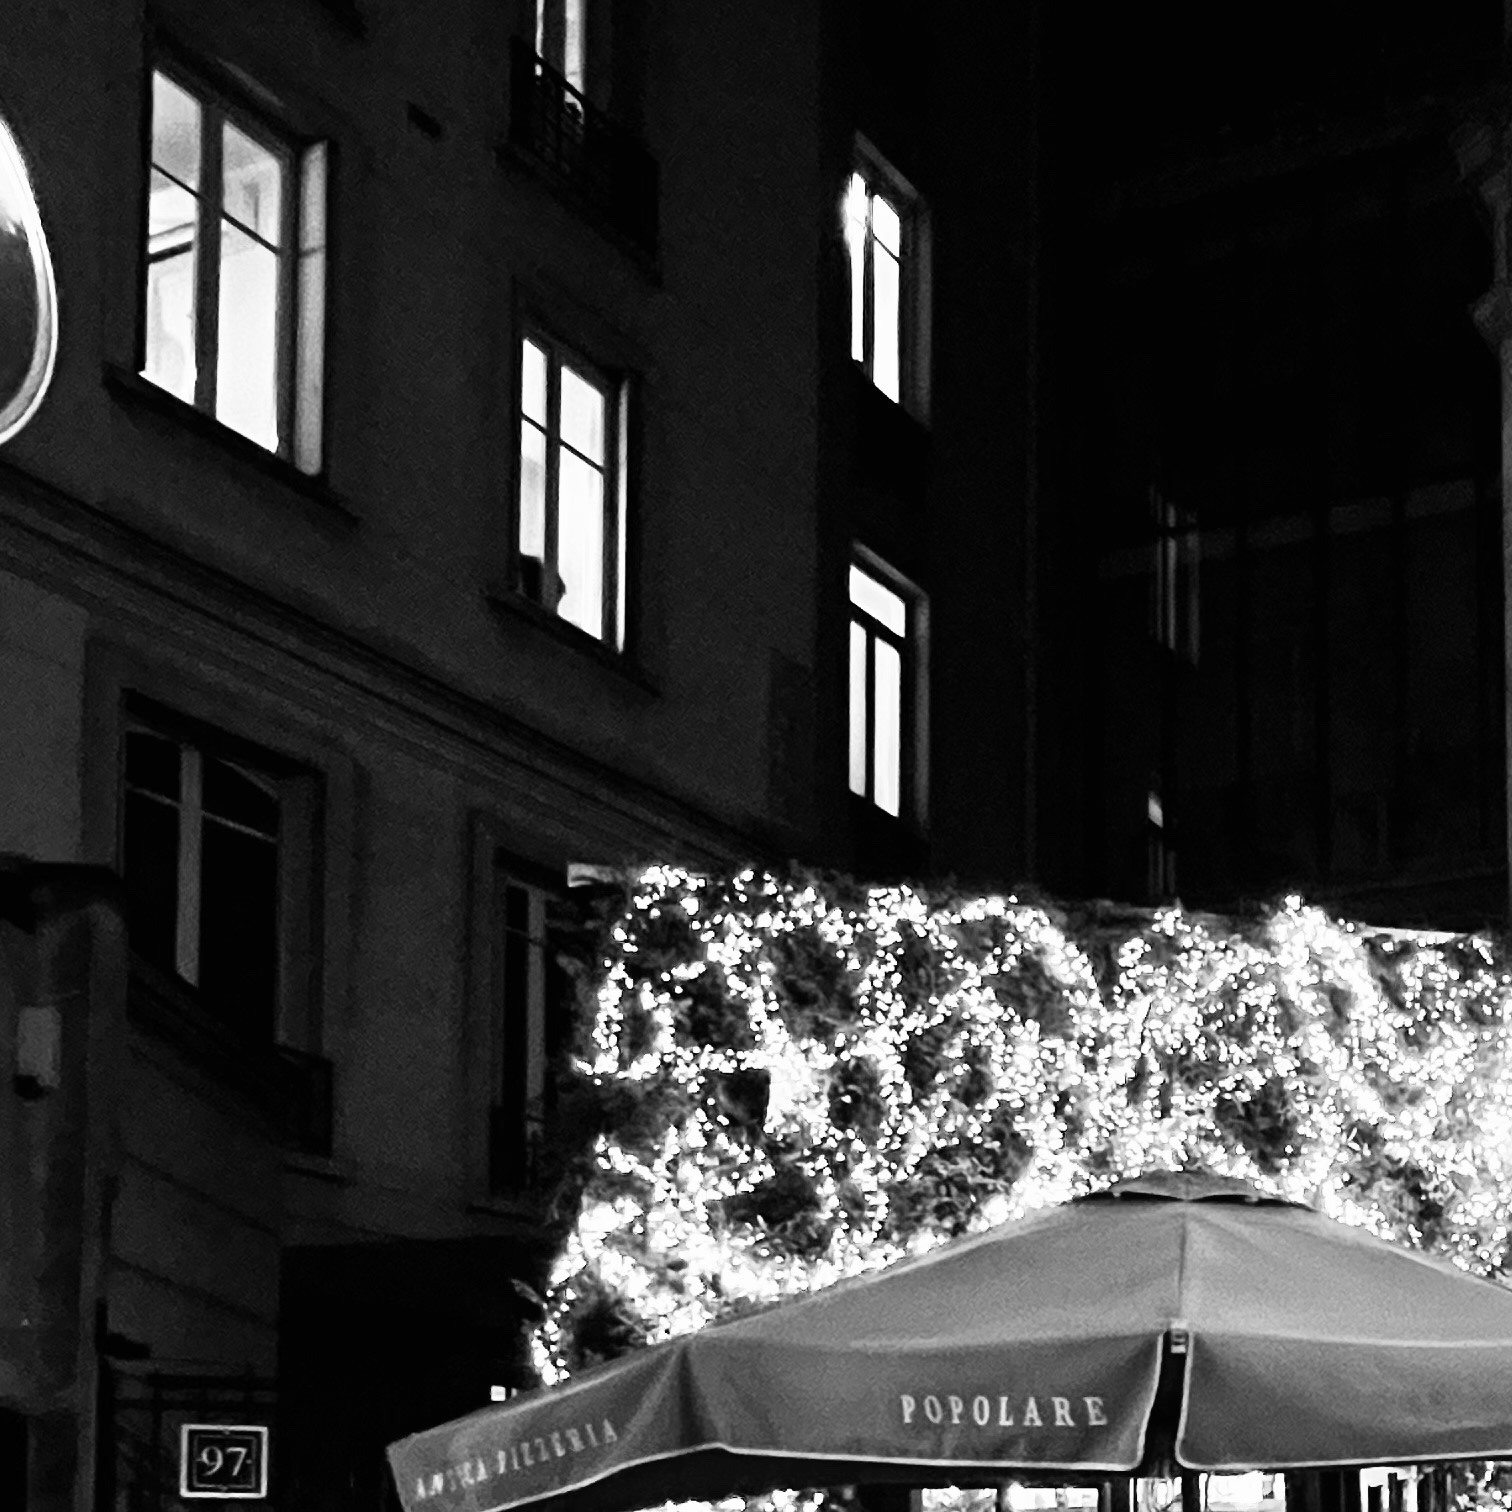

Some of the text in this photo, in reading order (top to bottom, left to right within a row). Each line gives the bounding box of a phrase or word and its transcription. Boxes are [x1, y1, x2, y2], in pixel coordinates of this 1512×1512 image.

[900, 1394, 1108, 1427] POPOLARE
[201, 1446, 248, 1476] 97
[498, 1418, 618, 1474] PIZZERIA
